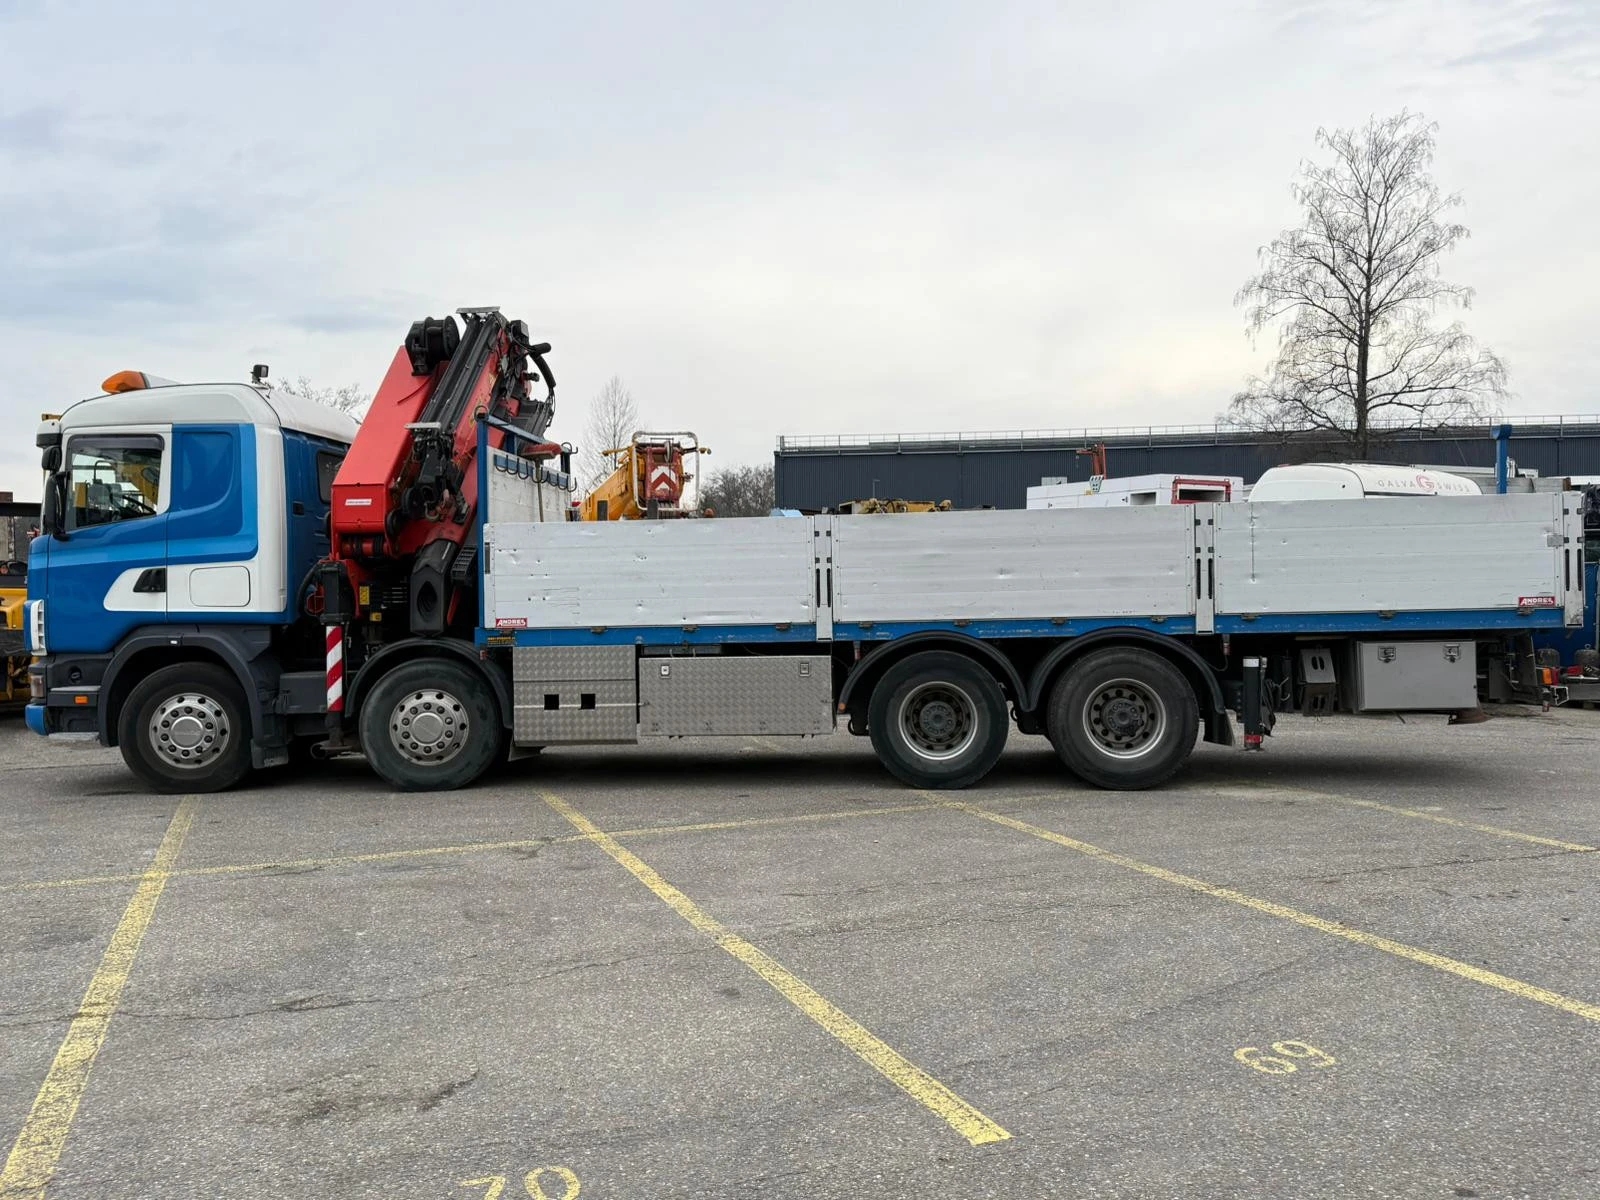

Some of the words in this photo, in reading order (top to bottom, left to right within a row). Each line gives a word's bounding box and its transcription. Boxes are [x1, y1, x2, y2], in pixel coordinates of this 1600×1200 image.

[1520, 597, 1554, 606] ANDRES
[496, 618, 526, 627] ANDRES
[1233, 1040, 1336, 1074] 69
